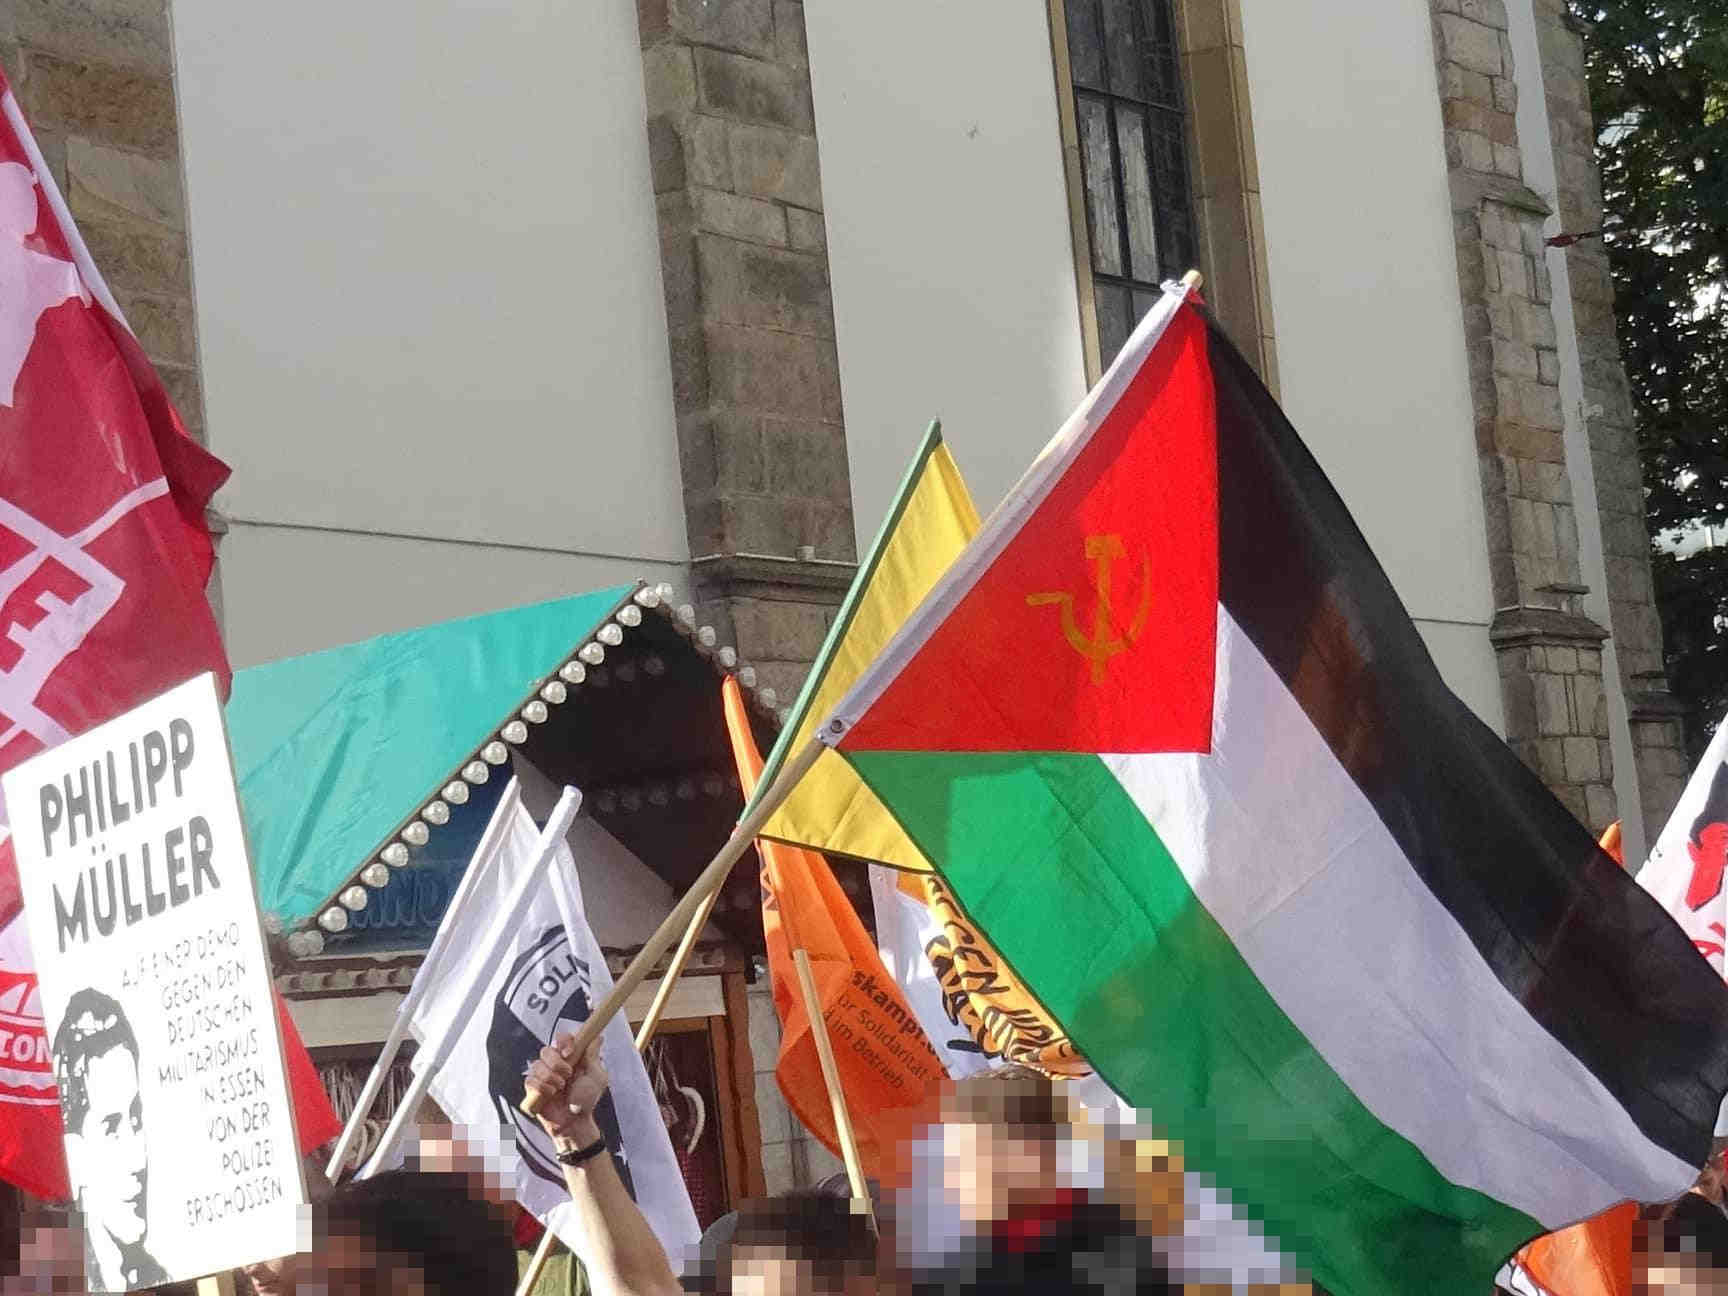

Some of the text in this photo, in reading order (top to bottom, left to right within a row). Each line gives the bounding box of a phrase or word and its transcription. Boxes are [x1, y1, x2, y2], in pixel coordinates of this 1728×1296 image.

[39, 717, 195, 858] PHILIPP
[52, 815, 221, 954] MÜLLER
[161, 959, 247, 1012] GEGEN DEN
[219, 1066, 266, 1105] ESSEN
[207, 1100, 271, 1143] VON DER
